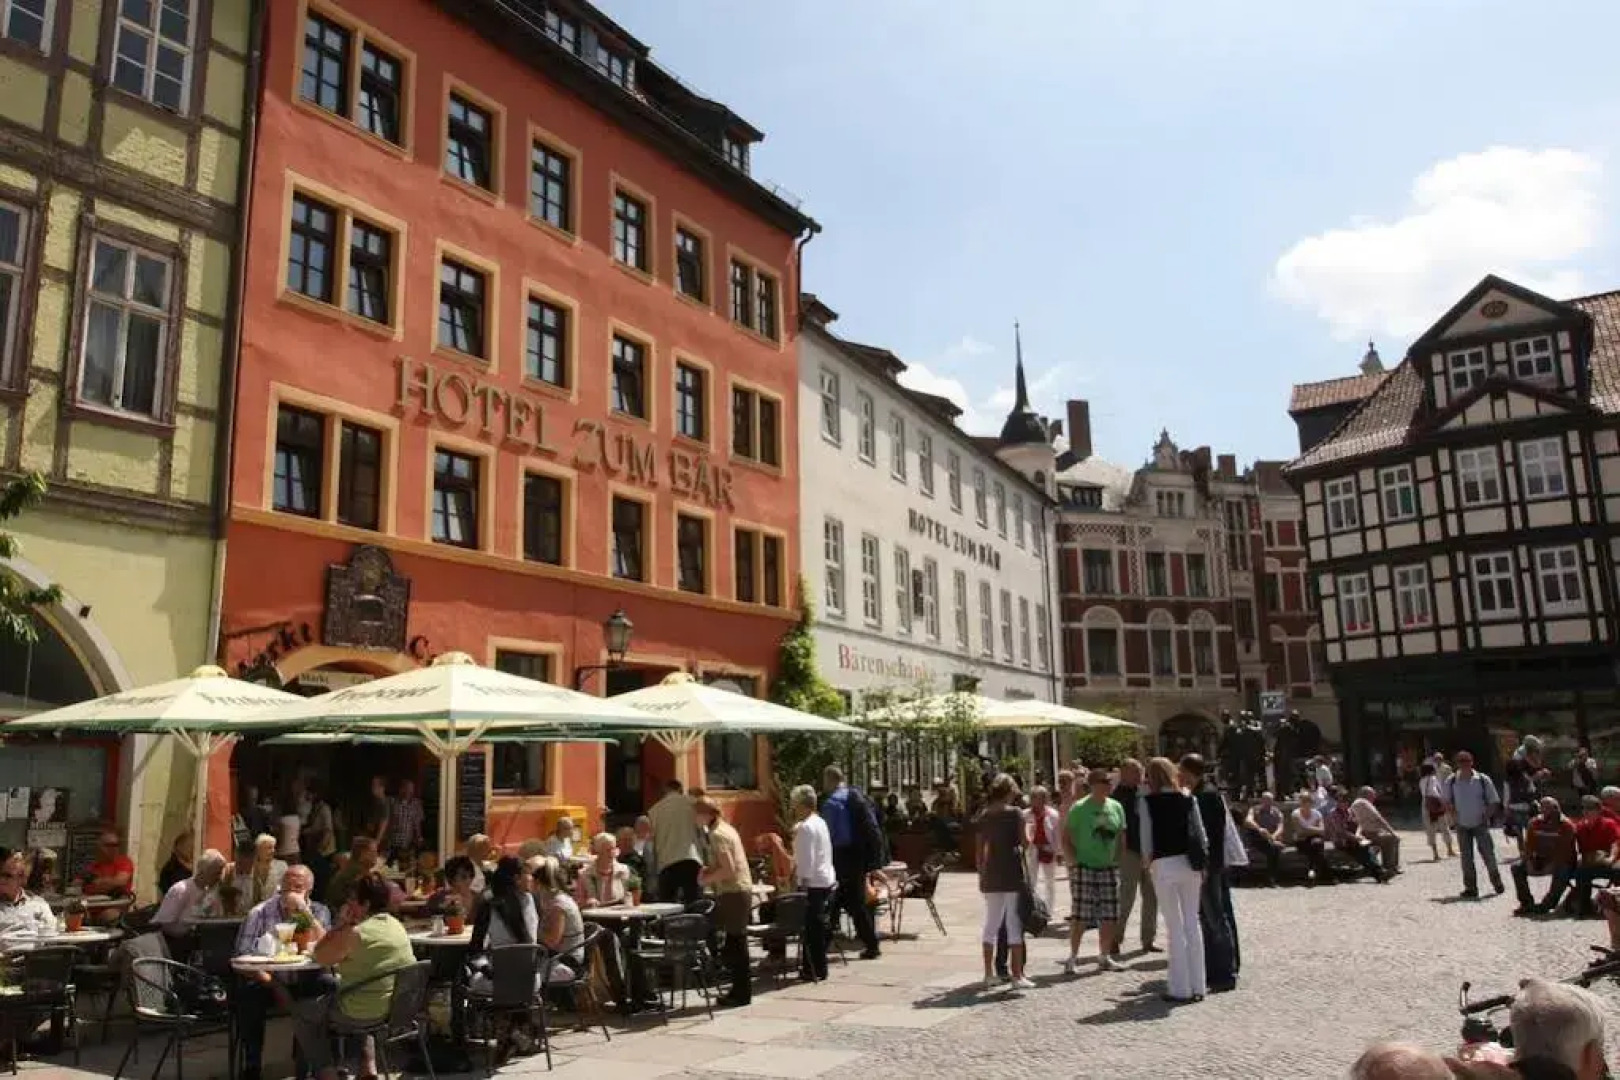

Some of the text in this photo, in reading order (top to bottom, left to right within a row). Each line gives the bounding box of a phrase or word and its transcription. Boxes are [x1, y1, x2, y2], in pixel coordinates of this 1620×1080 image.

[394, 354, 736, 513] HOTEL ZUM BÄR
[908, 507, 951, 548] HOTEL
[953, 531, 978, 562] ZUM
